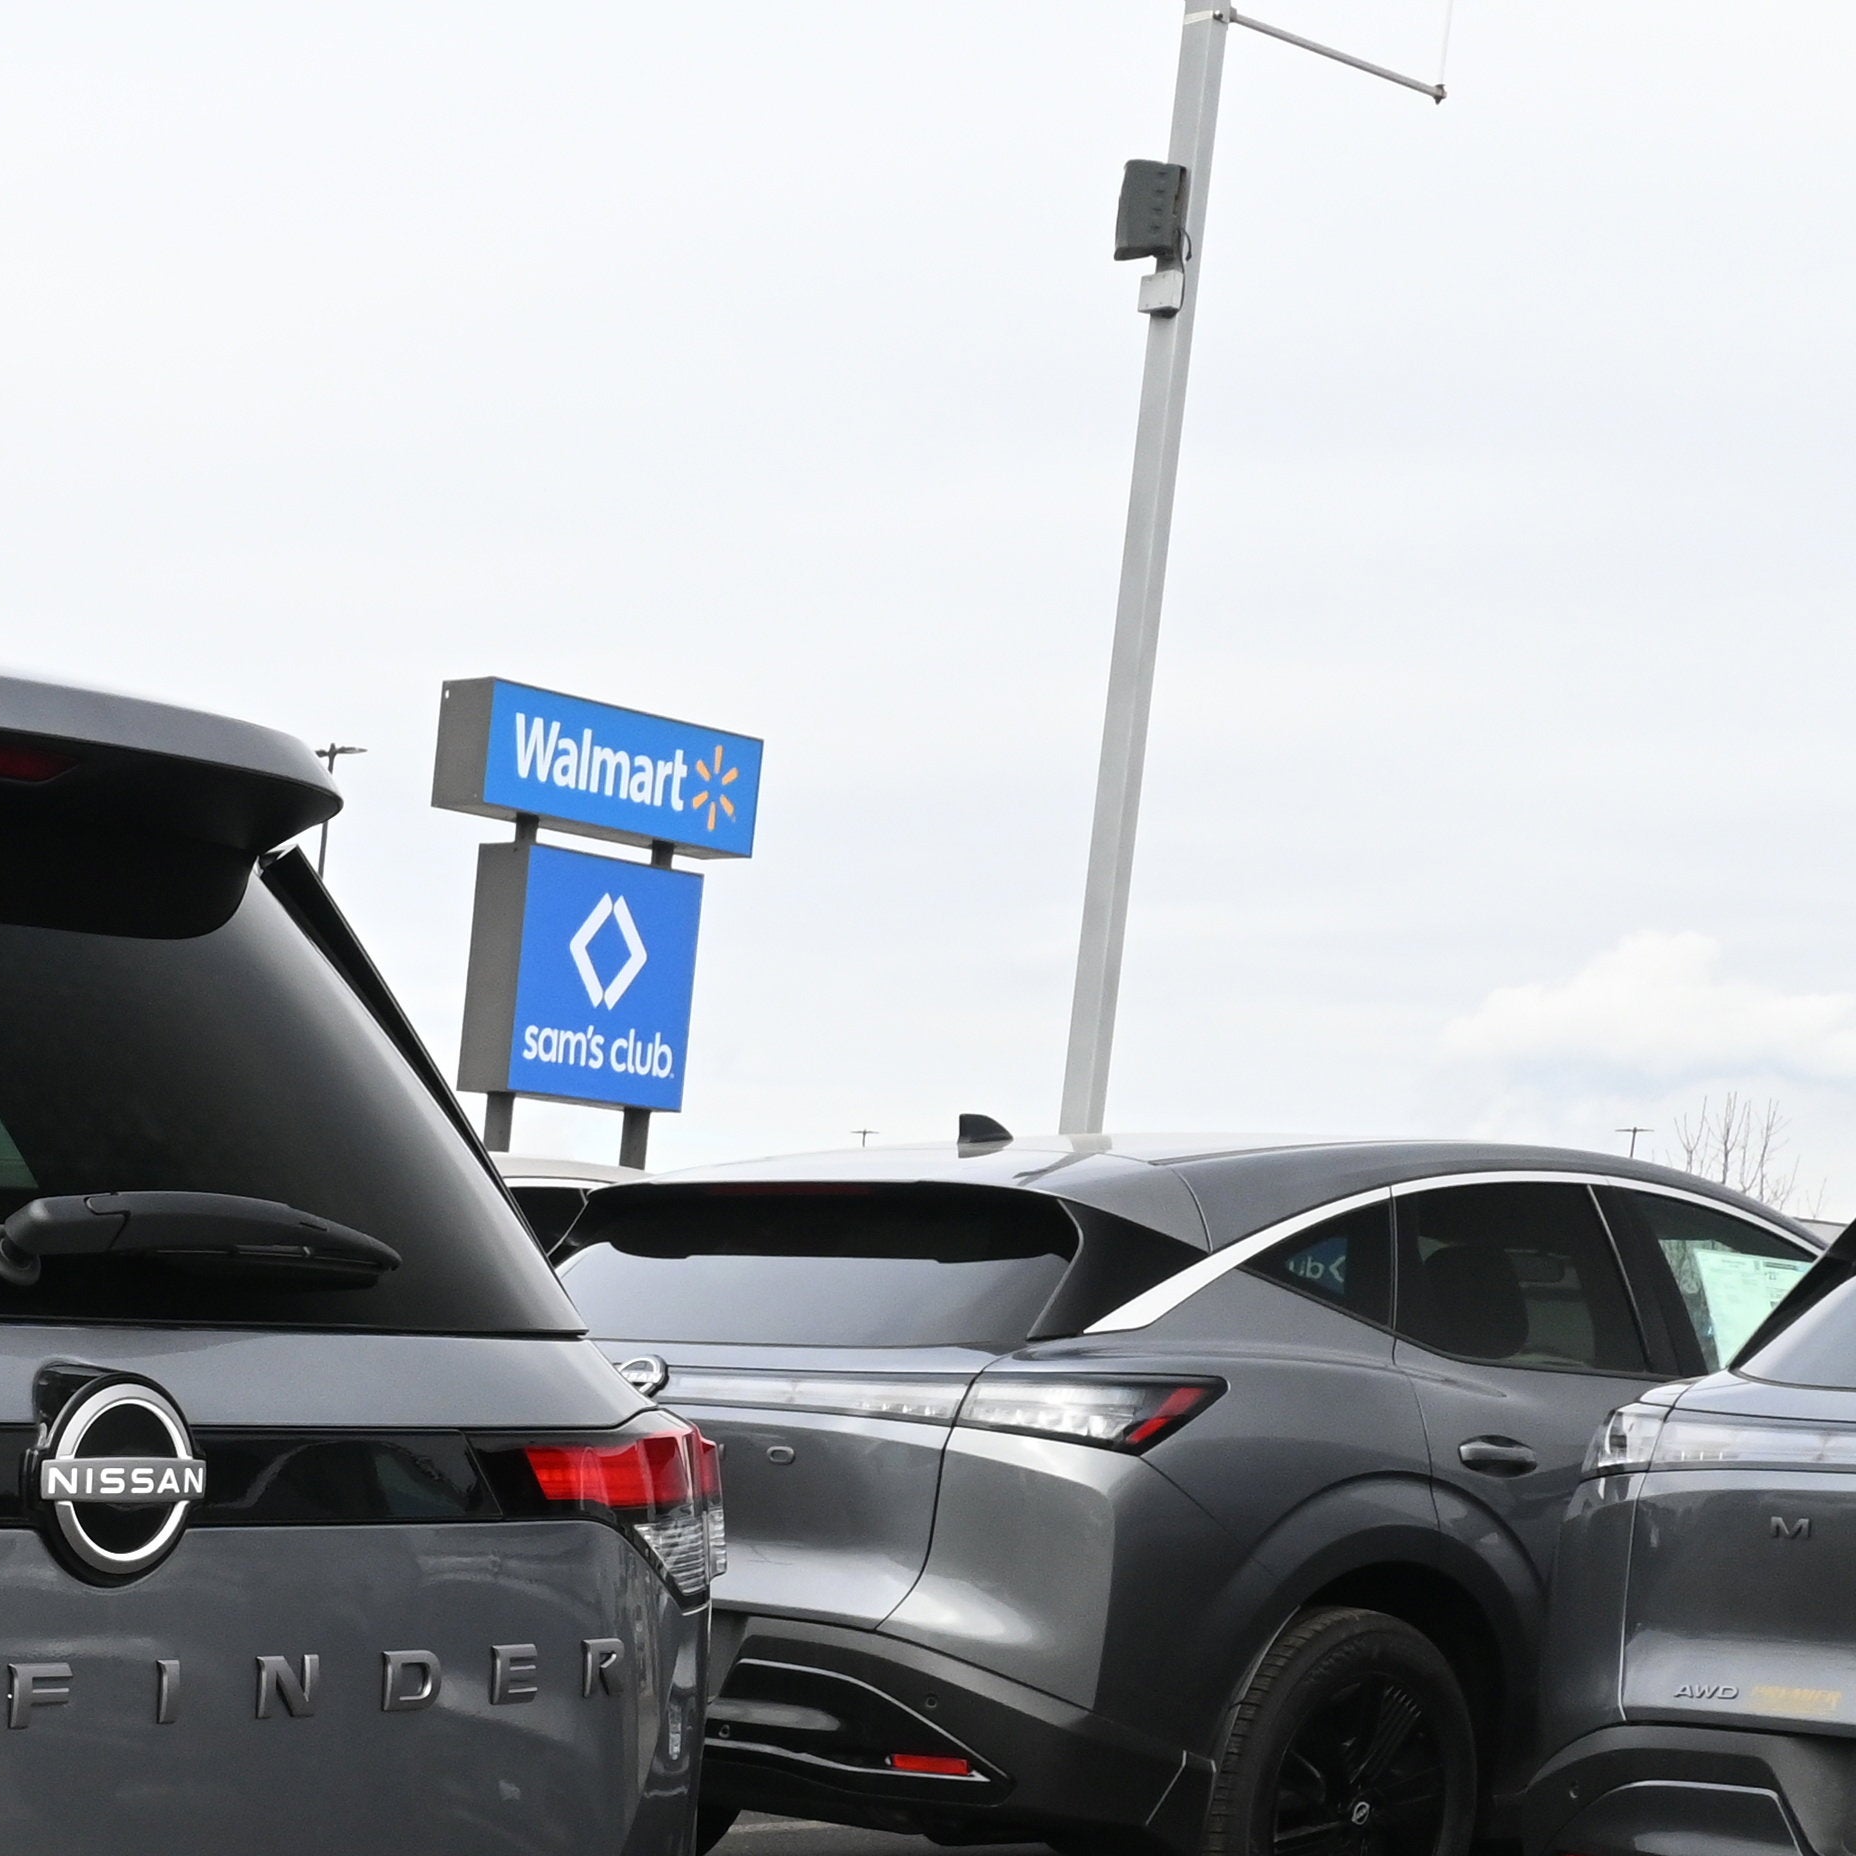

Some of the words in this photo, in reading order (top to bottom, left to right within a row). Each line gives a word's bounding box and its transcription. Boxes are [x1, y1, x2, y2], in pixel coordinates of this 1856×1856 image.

[515, 712, 688, 811] Walmart
[522, 1025, 604, 1069] sam's
[610, 1028, 672, 1078] club
[47, 1467, 204, 1494] NISSAN
[1673, 1684, 1739, 1699] AWD
